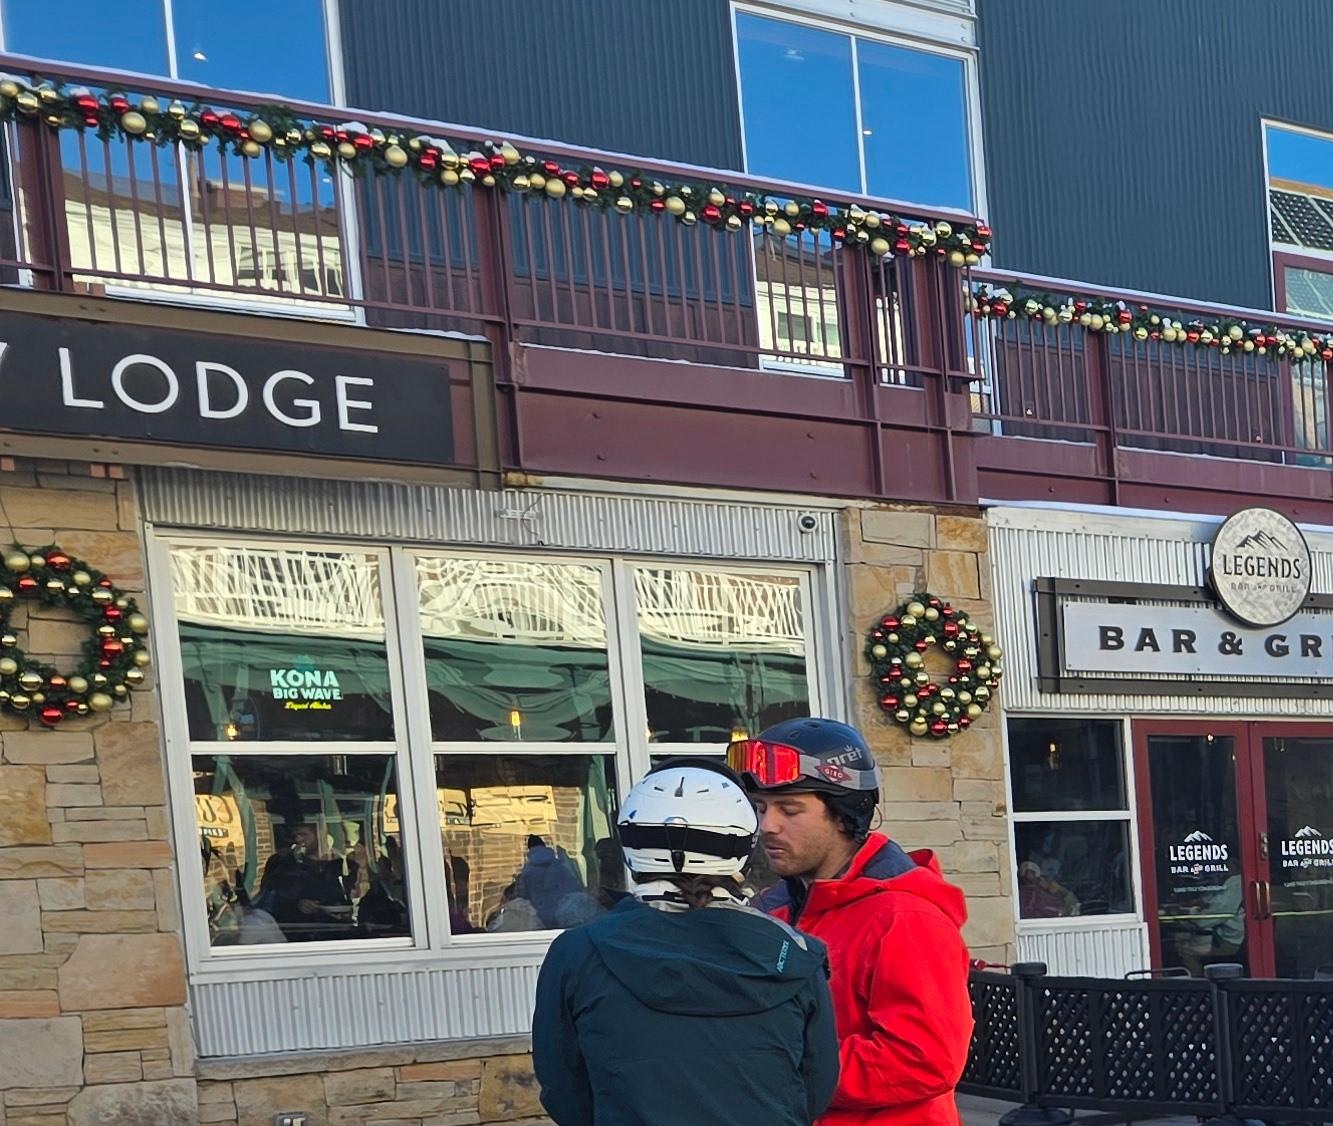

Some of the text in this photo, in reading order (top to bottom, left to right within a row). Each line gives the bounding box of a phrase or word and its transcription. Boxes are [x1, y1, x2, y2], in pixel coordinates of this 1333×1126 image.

[58, 347, 379, 433] LODGE
[1223, 554, 1301, 579] LEGENDS
[1098, 626, 1197, 654] BAR
[1218, 631, 1243, 655] &
[270, 669, 340, 688] KONA
[273, 687, 342, 700] BIG WAVE
[823, 767, 845, 779] GIRO
[1169, 843, 1228, 861] LEGENDS
[1171, 866, 1189, 874] BAR
[1204, 864, 1229, 873] GRILL
[1282, 860, 1299, 868] BAR
